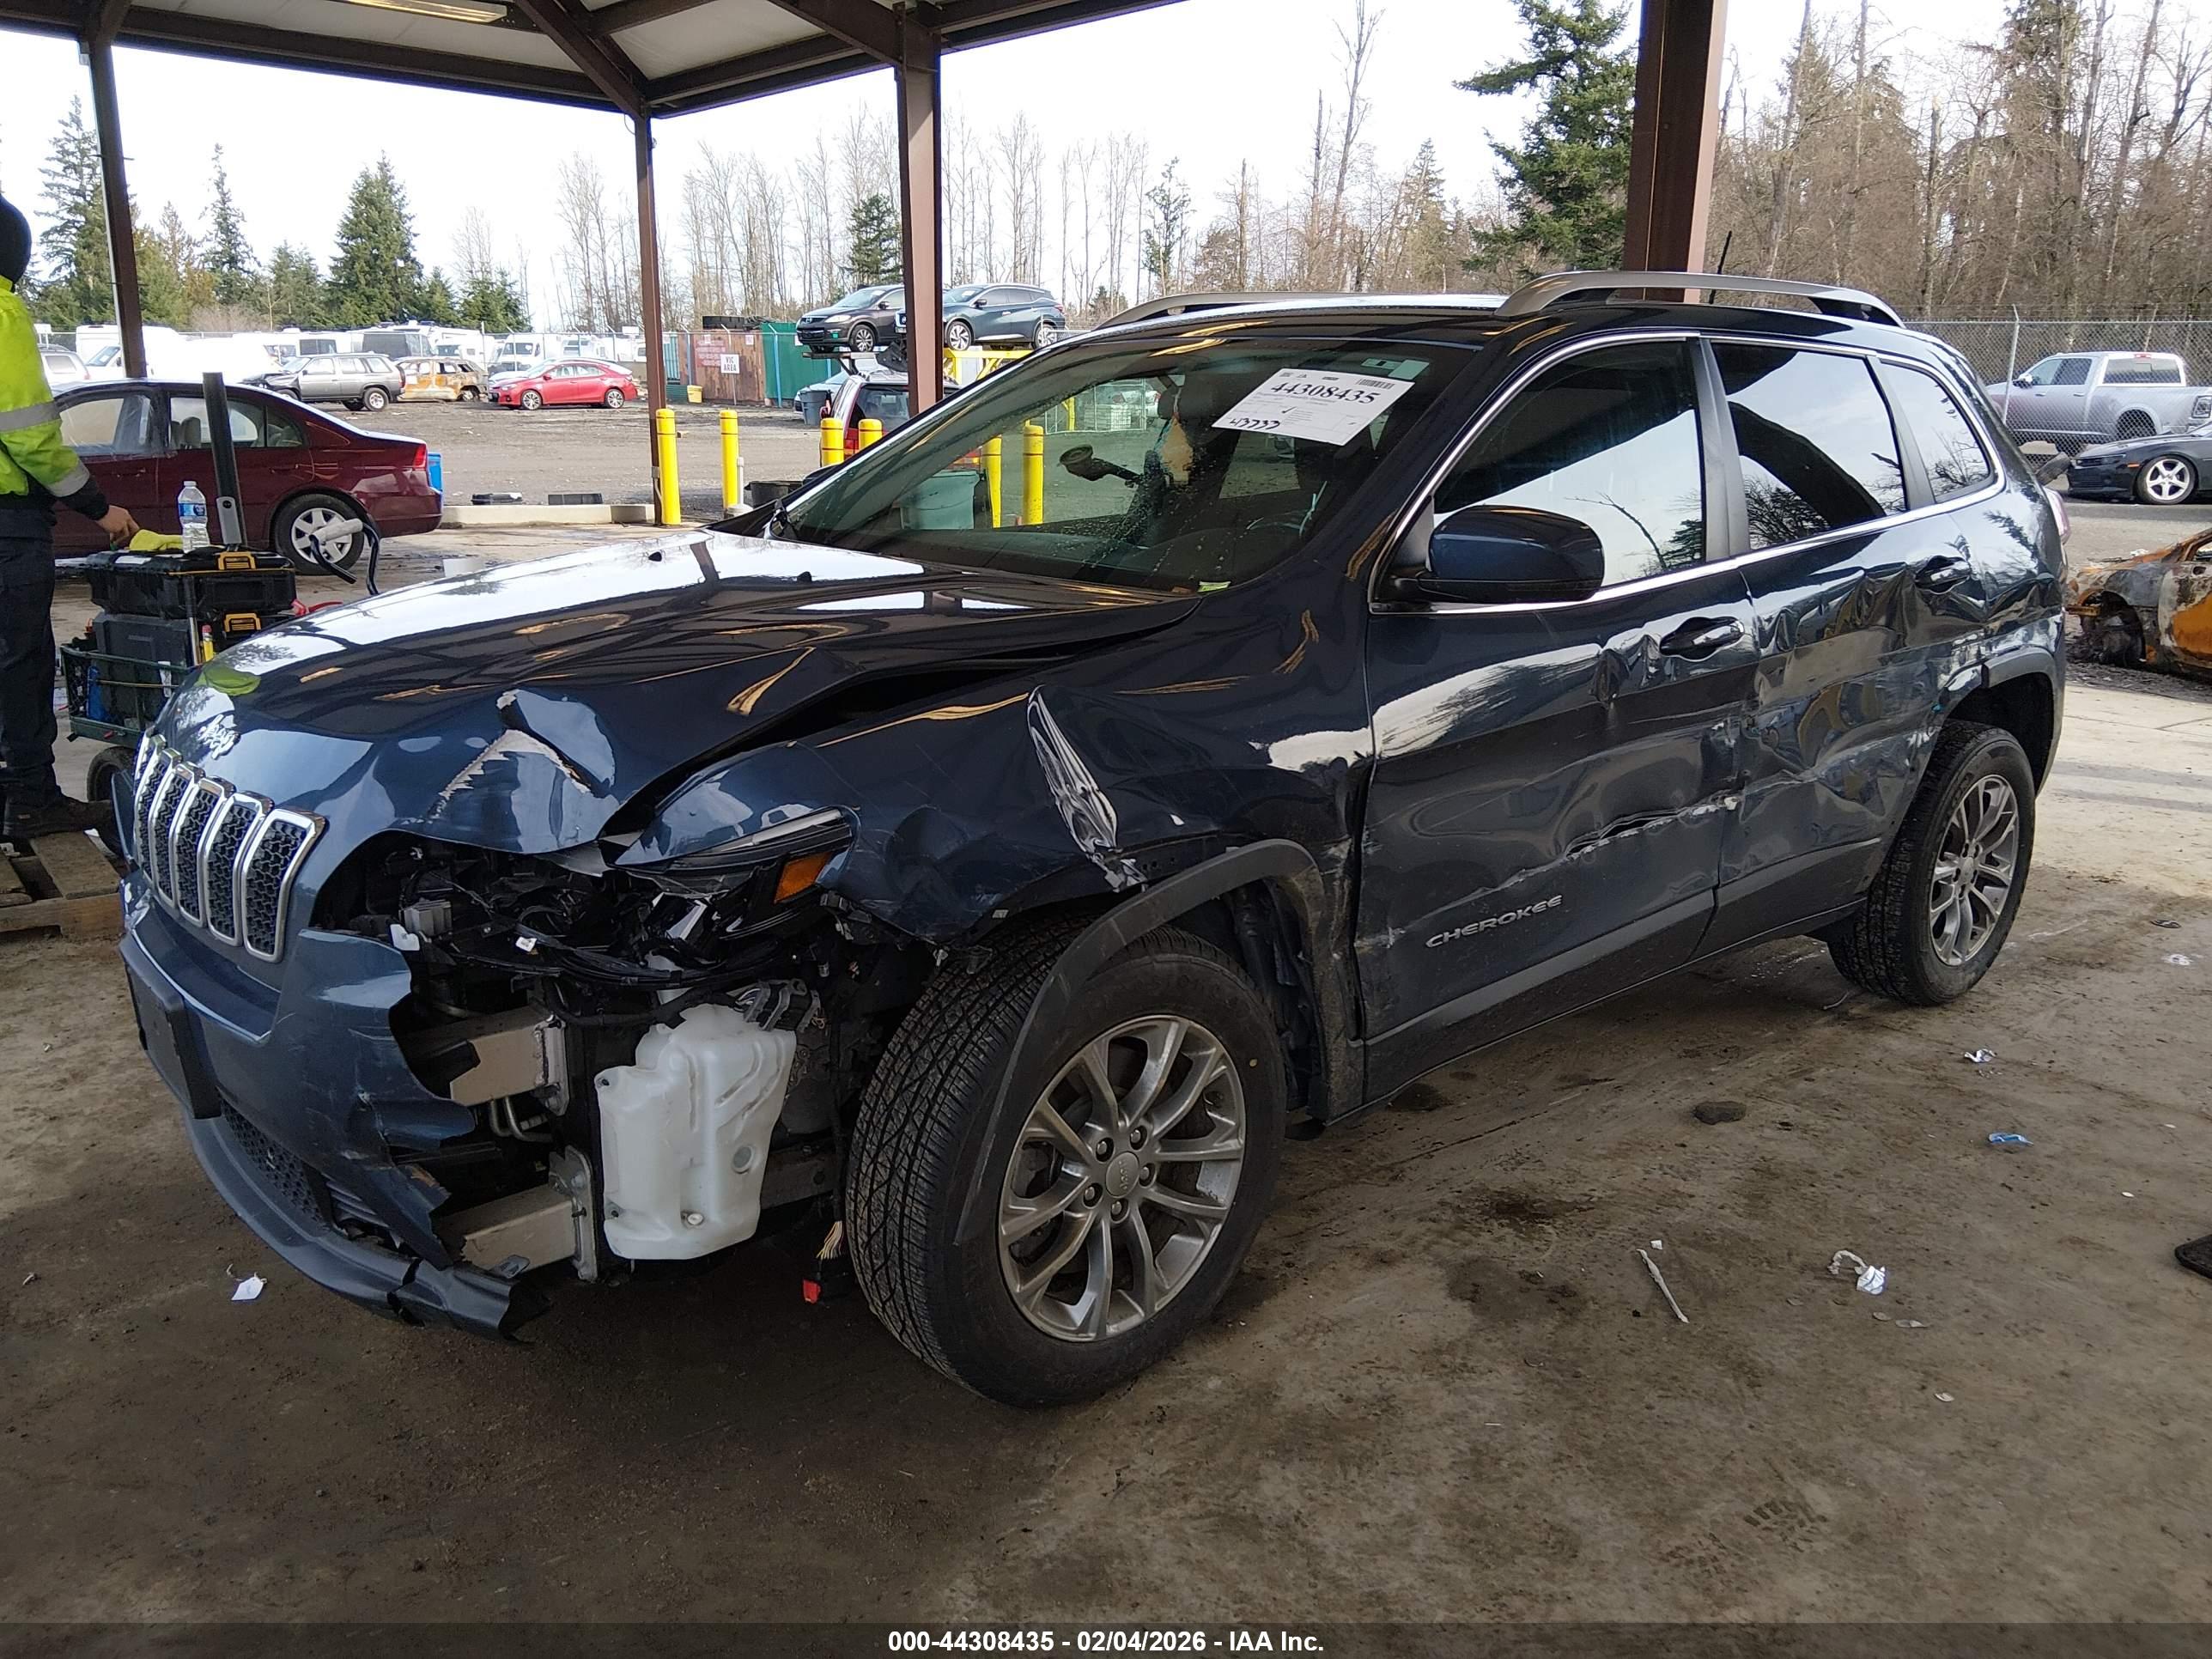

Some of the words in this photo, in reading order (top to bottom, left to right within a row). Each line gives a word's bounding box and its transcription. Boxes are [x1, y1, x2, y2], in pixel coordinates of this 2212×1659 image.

[723, 363, 738, 372] AREA
[1271, 382, 1381, 404] 44308435
[1425, 895, 1563, 948] CHEROKEE
